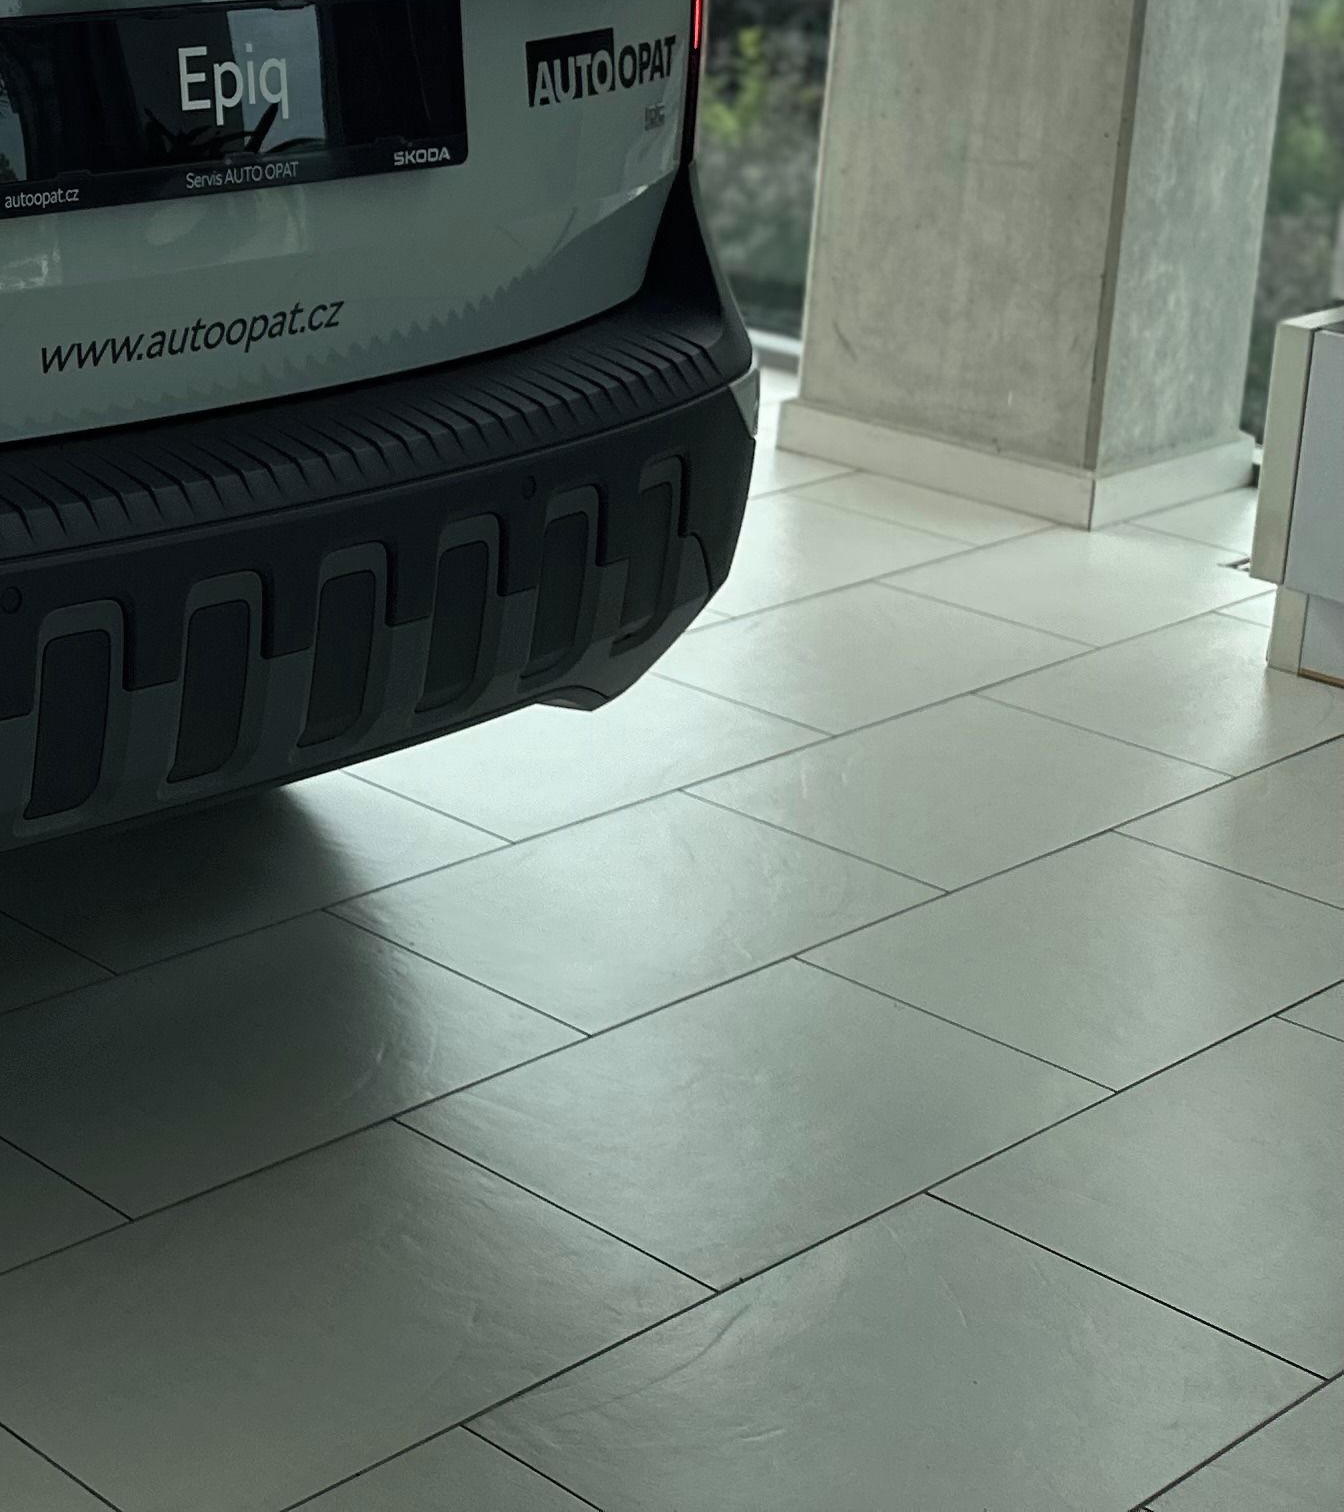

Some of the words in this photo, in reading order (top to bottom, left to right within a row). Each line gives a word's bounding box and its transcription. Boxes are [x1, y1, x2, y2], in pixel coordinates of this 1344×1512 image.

[176, 43, 291, 126] Epiq
[533, 49, 614, 106] AUTO
[618, 34, 677, 90] OPAT
[185, 170, 223, 190] Servis
[224, 164, 263, 185] AUTO
[265, 160, 300, 180] OPAT
[393, 147, 451, 167] SKODA
[3, 187, 80, 210] autoopat.cz
[39, 297, 345, 376] www.autoopat.cz
